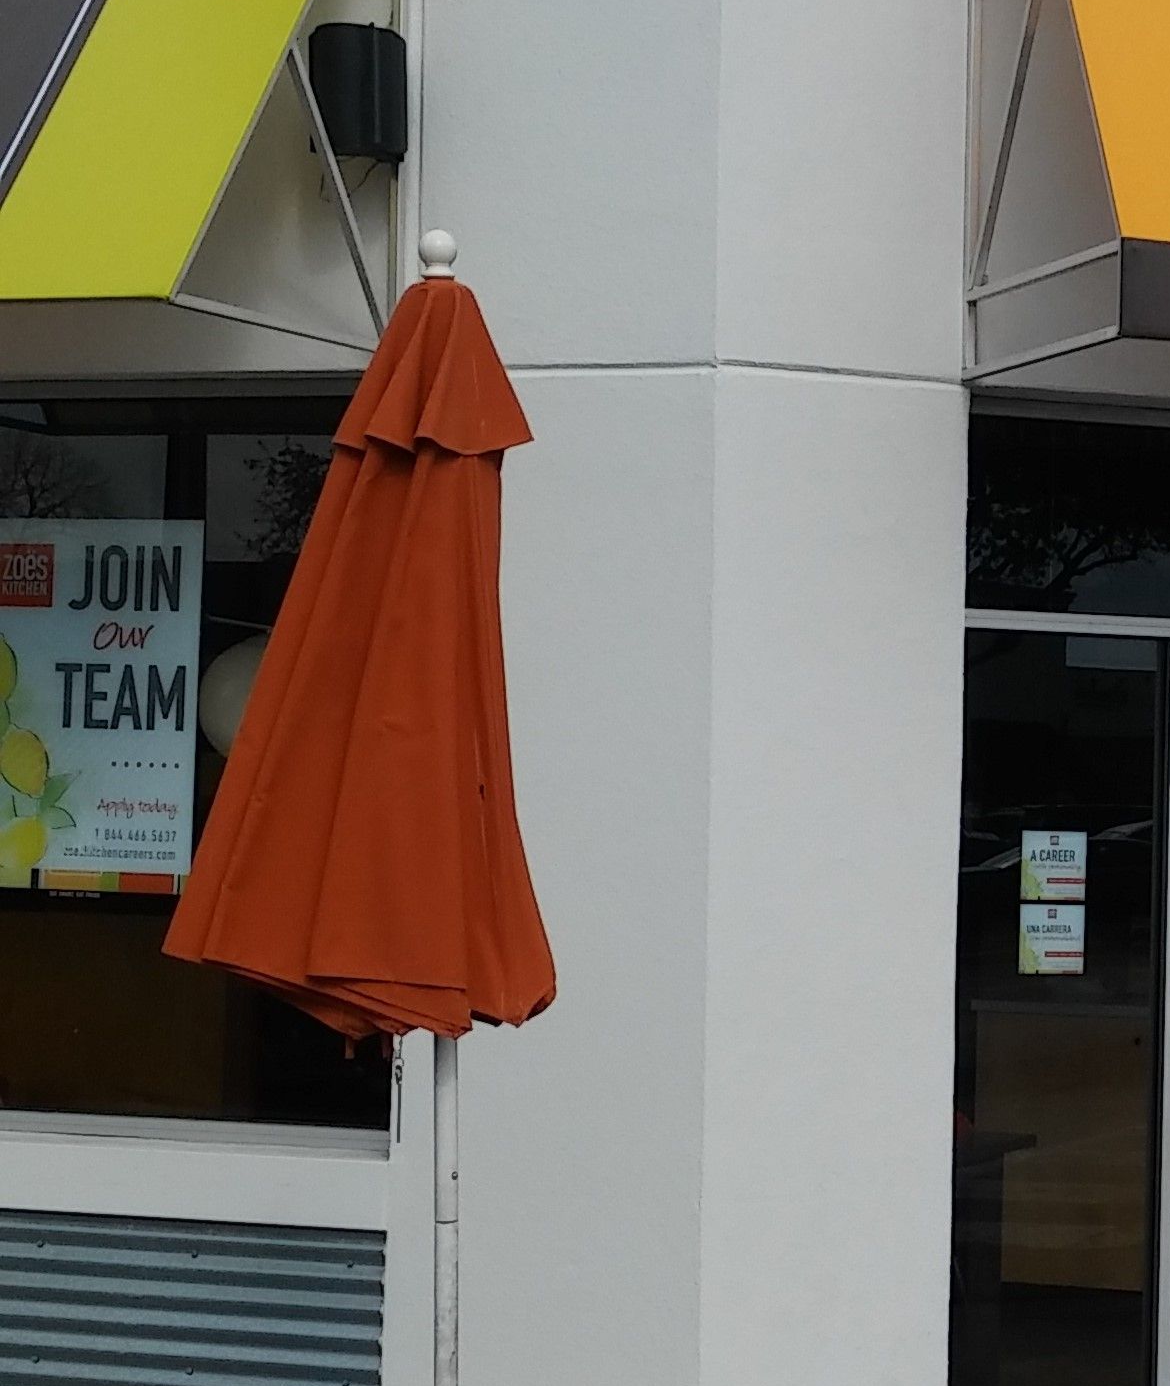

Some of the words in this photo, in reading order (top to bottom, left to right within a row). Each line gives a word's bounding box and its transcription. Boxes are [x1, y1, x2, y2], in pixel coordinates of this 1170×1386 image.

[2, 580, 48, 596] KITCHEN
[68, 544, 182, 612] JOIN
[93, 621, 154, 650] Our
[55, 662, 187, 731] TEAM
[97, 797, 134, 819] Apply
[1030, 849, 1037, 861] A
[1039, 849, 1075, 863] CAREER
